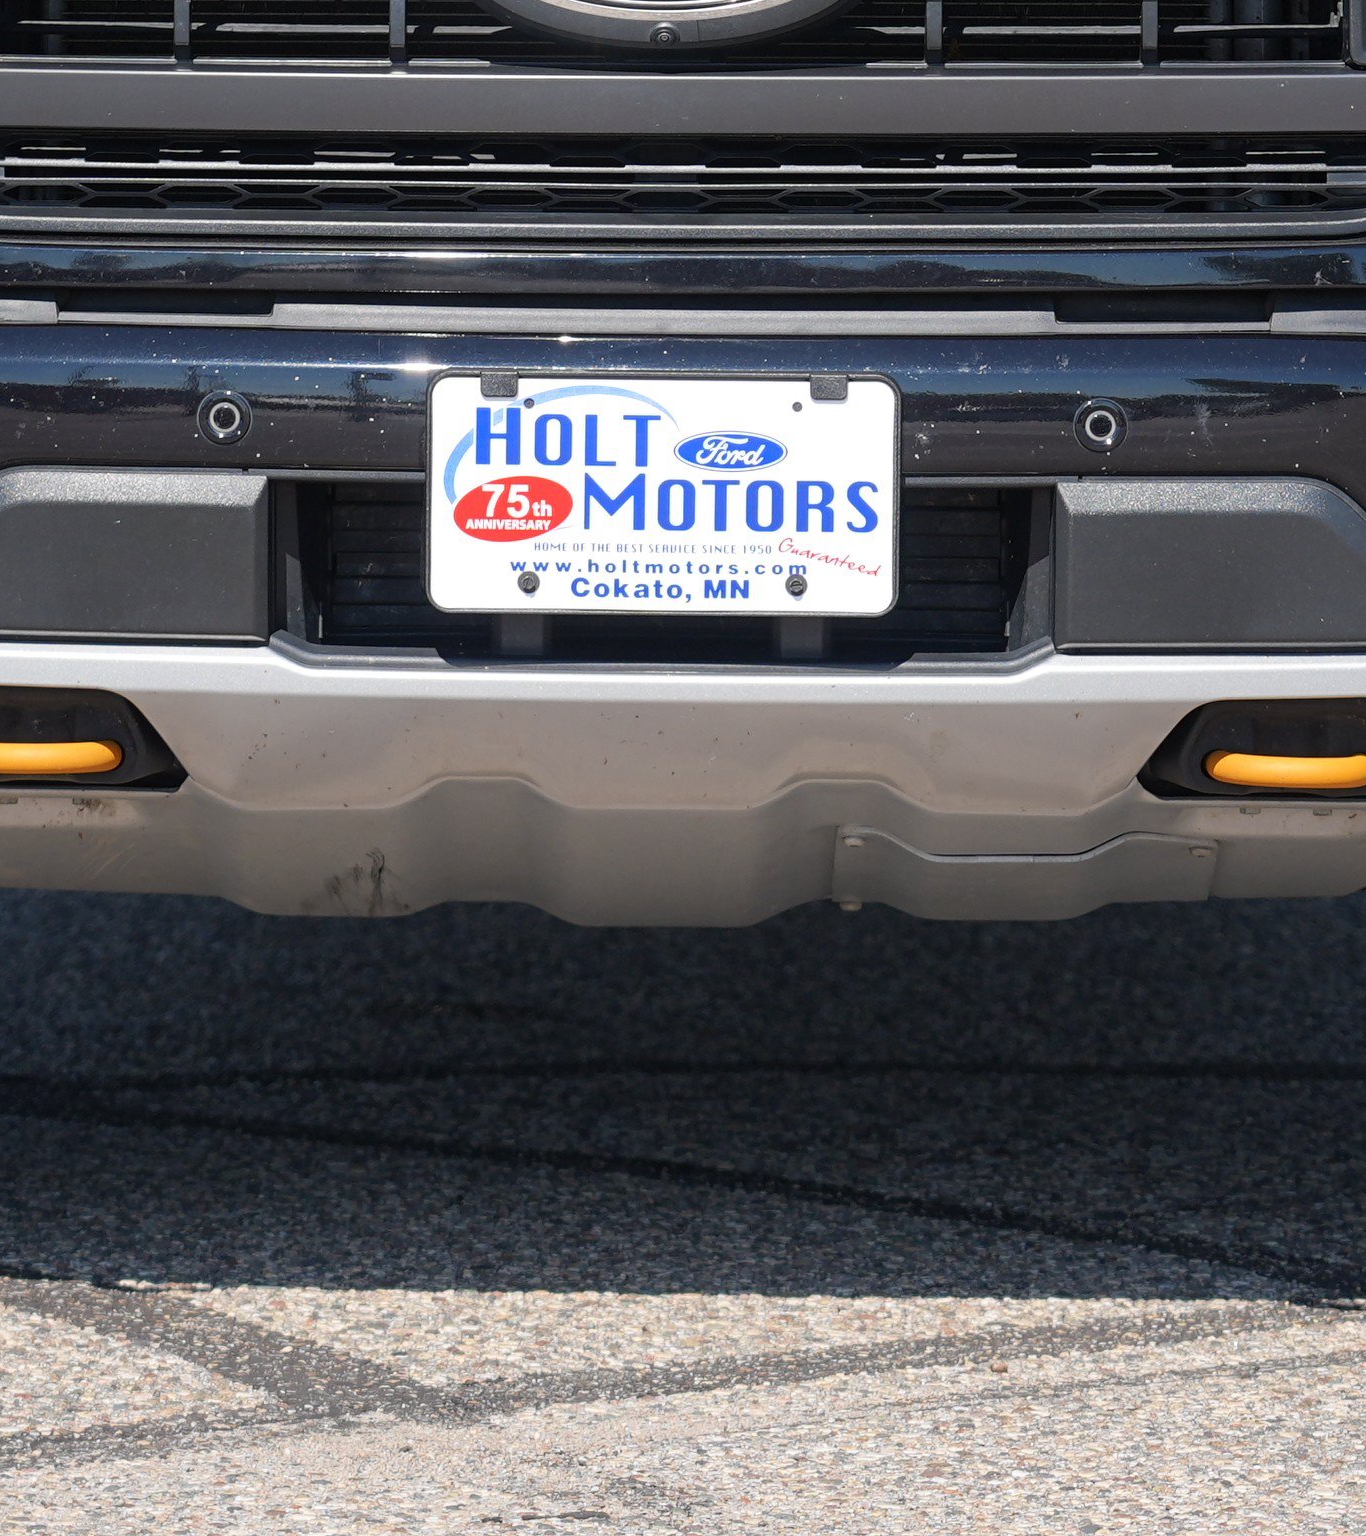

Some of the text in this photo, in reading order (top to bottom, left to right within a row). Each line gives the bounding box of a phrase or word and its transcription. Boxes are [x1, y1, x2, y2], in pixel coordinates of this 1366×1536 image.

[475, 407, 661, 467] HOLT
[695, 435, 766, 466] Ford
[481, 484, 553, 518] 75th
[584, 472, 879, 533] MOTORS
[465, 518, 551, 531] ANNIVERSARY
[534, 542, 772, 555] HOME OF THE BEST SERVICE SINCE 1950
[778, 537, 882, 577] Guaranteed
[510, 559, 807, 575] www.holtmotors.com
[570, 577, 750, 603] Cokato, MN
